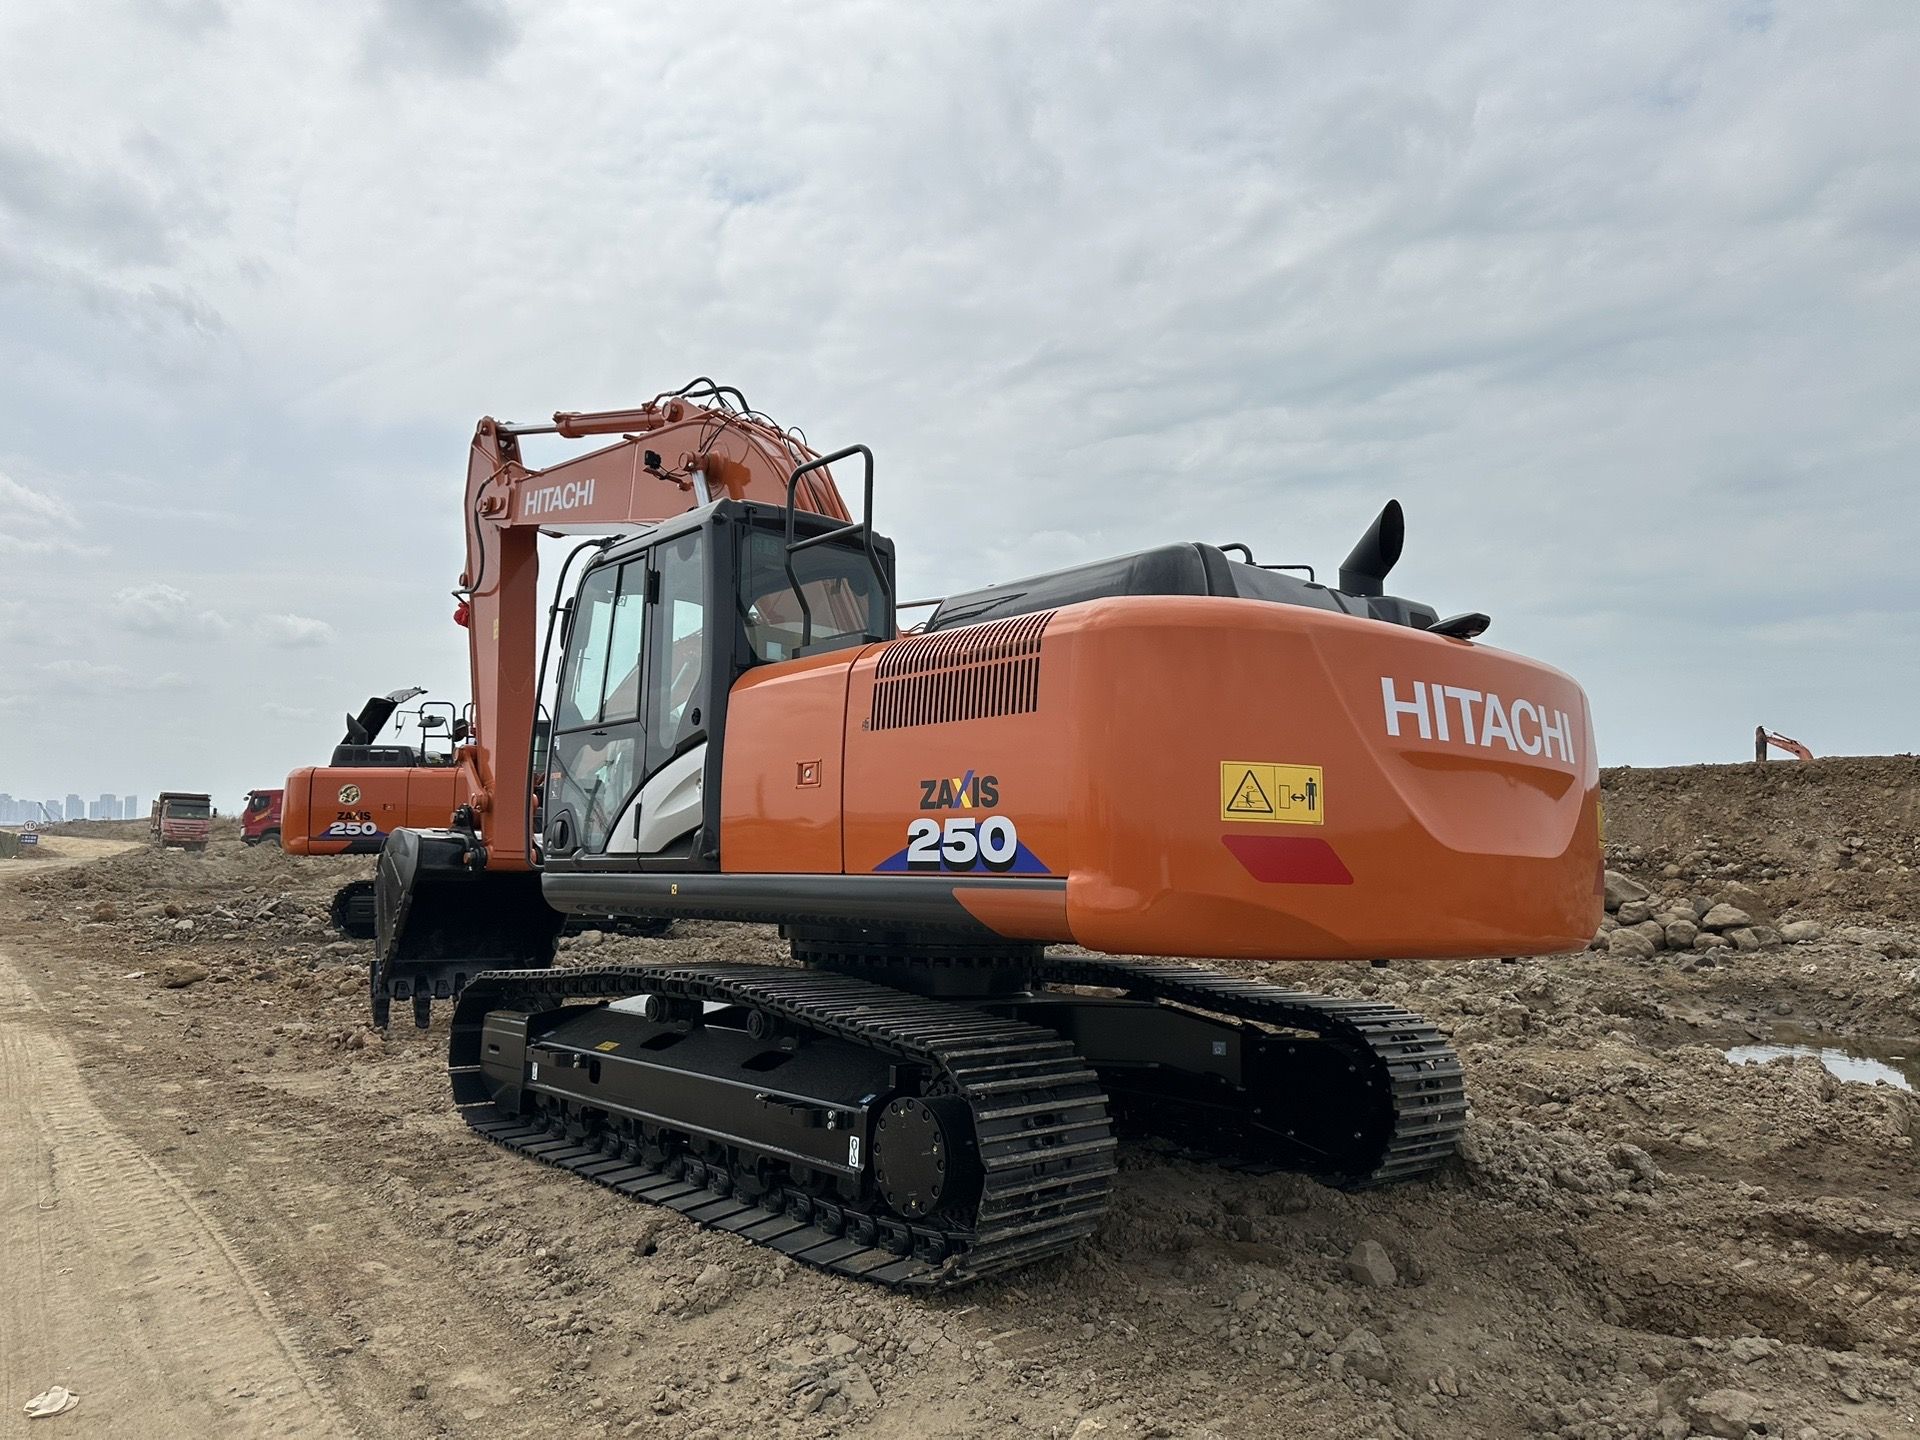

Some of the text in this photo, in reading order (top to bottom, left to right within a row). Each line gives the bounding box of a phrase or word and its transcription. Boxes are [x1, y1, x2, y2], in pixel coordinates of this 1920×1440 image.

[524, 479, 595, 516] HITACHI
[1380, 676, 1576, 764] HITACHI
[919, 770, 999, 810] ZAXIS
[329, 821, 377, 836] 250
[337, 811, 371, 821] ZAXIS
[907, 815, 1018, 868] 250
